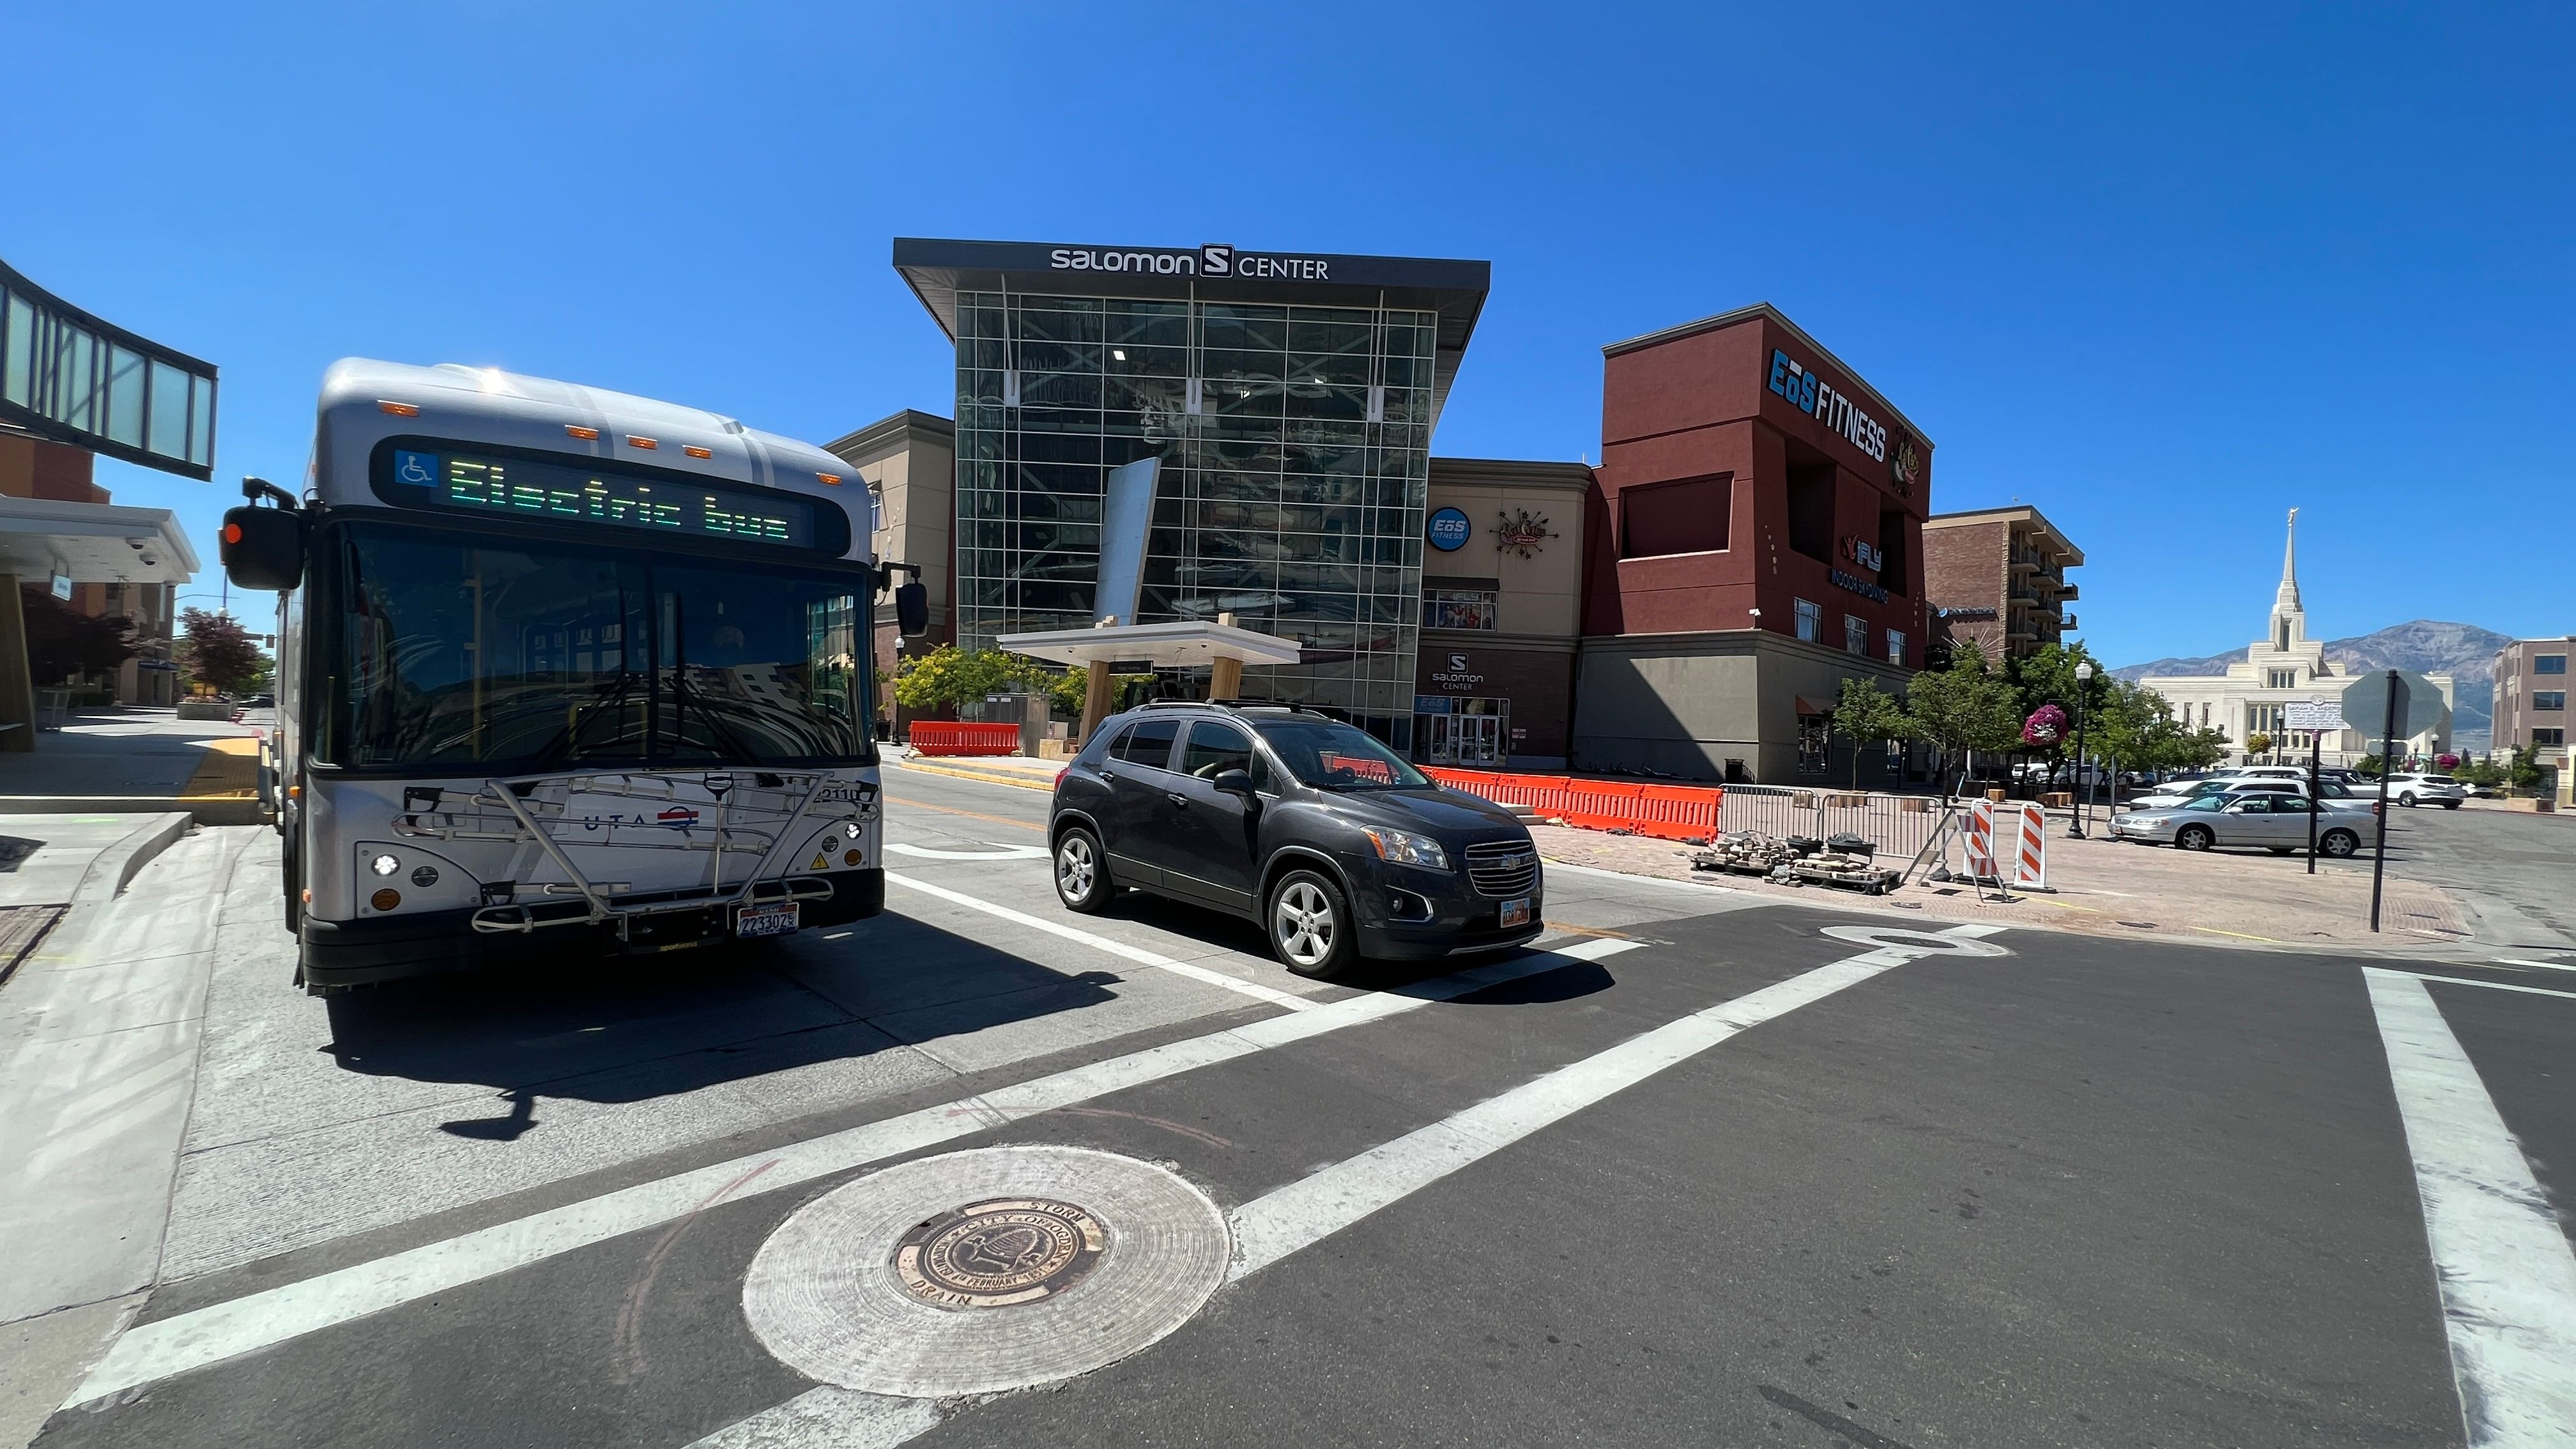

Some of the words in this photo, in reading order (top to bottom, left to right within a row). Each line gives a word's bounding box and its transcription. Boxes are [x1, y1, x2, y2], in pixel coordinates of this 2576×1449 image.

[1238, 257, 1329, 280] CENTER
[1816, 381, 1886, 463] FITNESS
[450, 461, 681, 525] Electric
[705, 496, 790, 539] bus
[1432, 532, 1464, 540] FITNESS
[1832, 568, 1858, 593] INDOOR
[585, 814, 645, 831] UTA
[741, 914, 787, 932] 223302
[1029, 1201, 1085, 1223] STORM
[965, 1215, 1013, 1230] CITY
[1024, 1216, 1049, 1225] OF
[1050, 1224, 1073, 1261] OGDEN
[910, 1280, 973, 1306] DRAIN
[967, 1276, 1018, 1287] FEBRUARY
